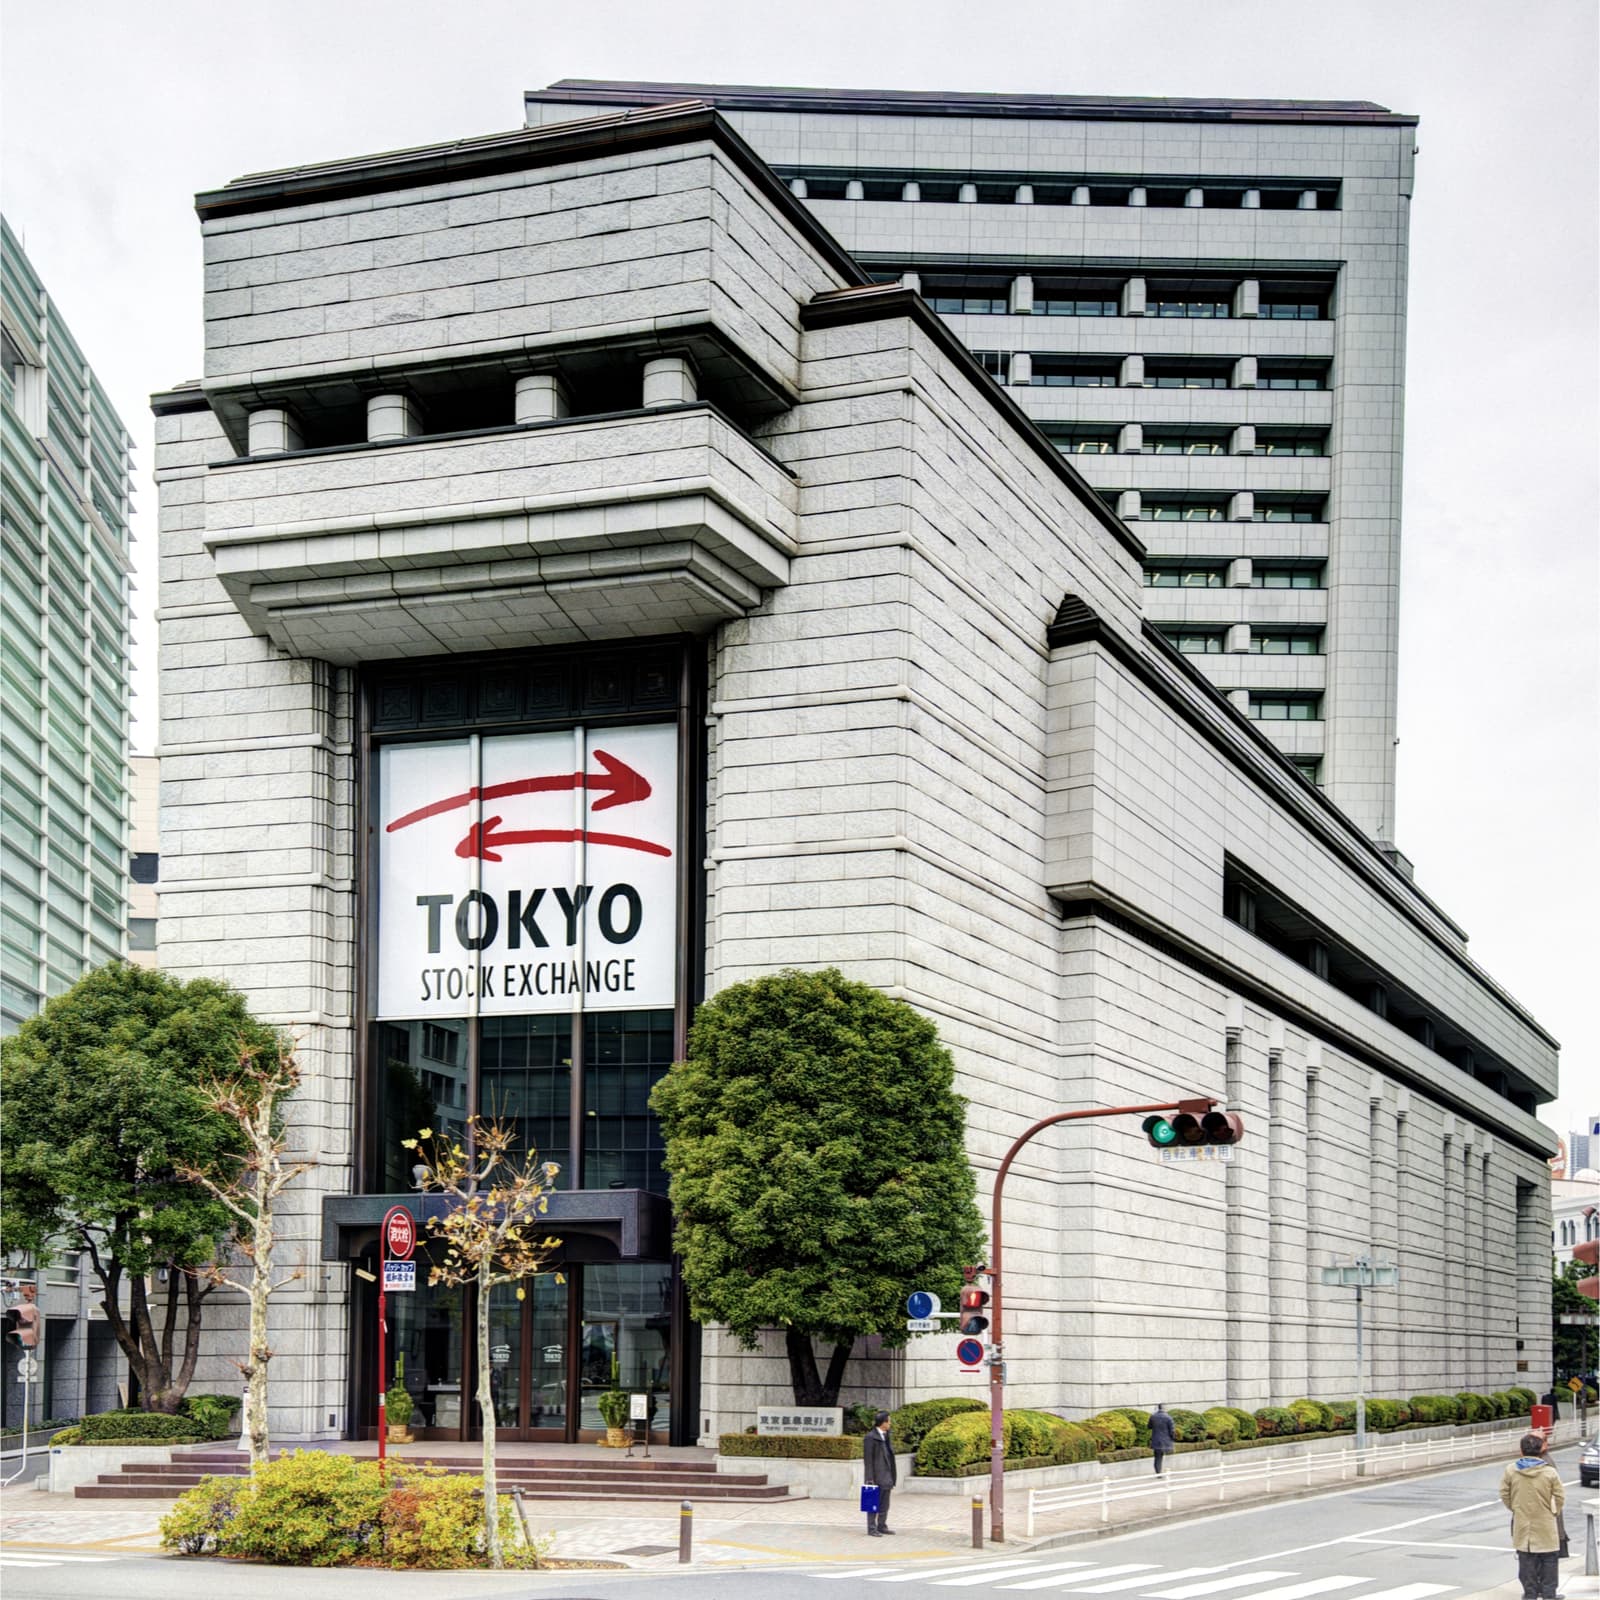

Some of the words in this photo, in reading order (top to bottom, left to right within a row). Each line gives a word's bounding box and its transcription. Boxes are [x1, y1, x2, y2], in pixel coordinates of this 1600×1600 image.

[417, 883, 642, 953] TOKYO
[421, 965, 494, 1000] STOCK
[504, 959, 635, 997] EXCHANGE
